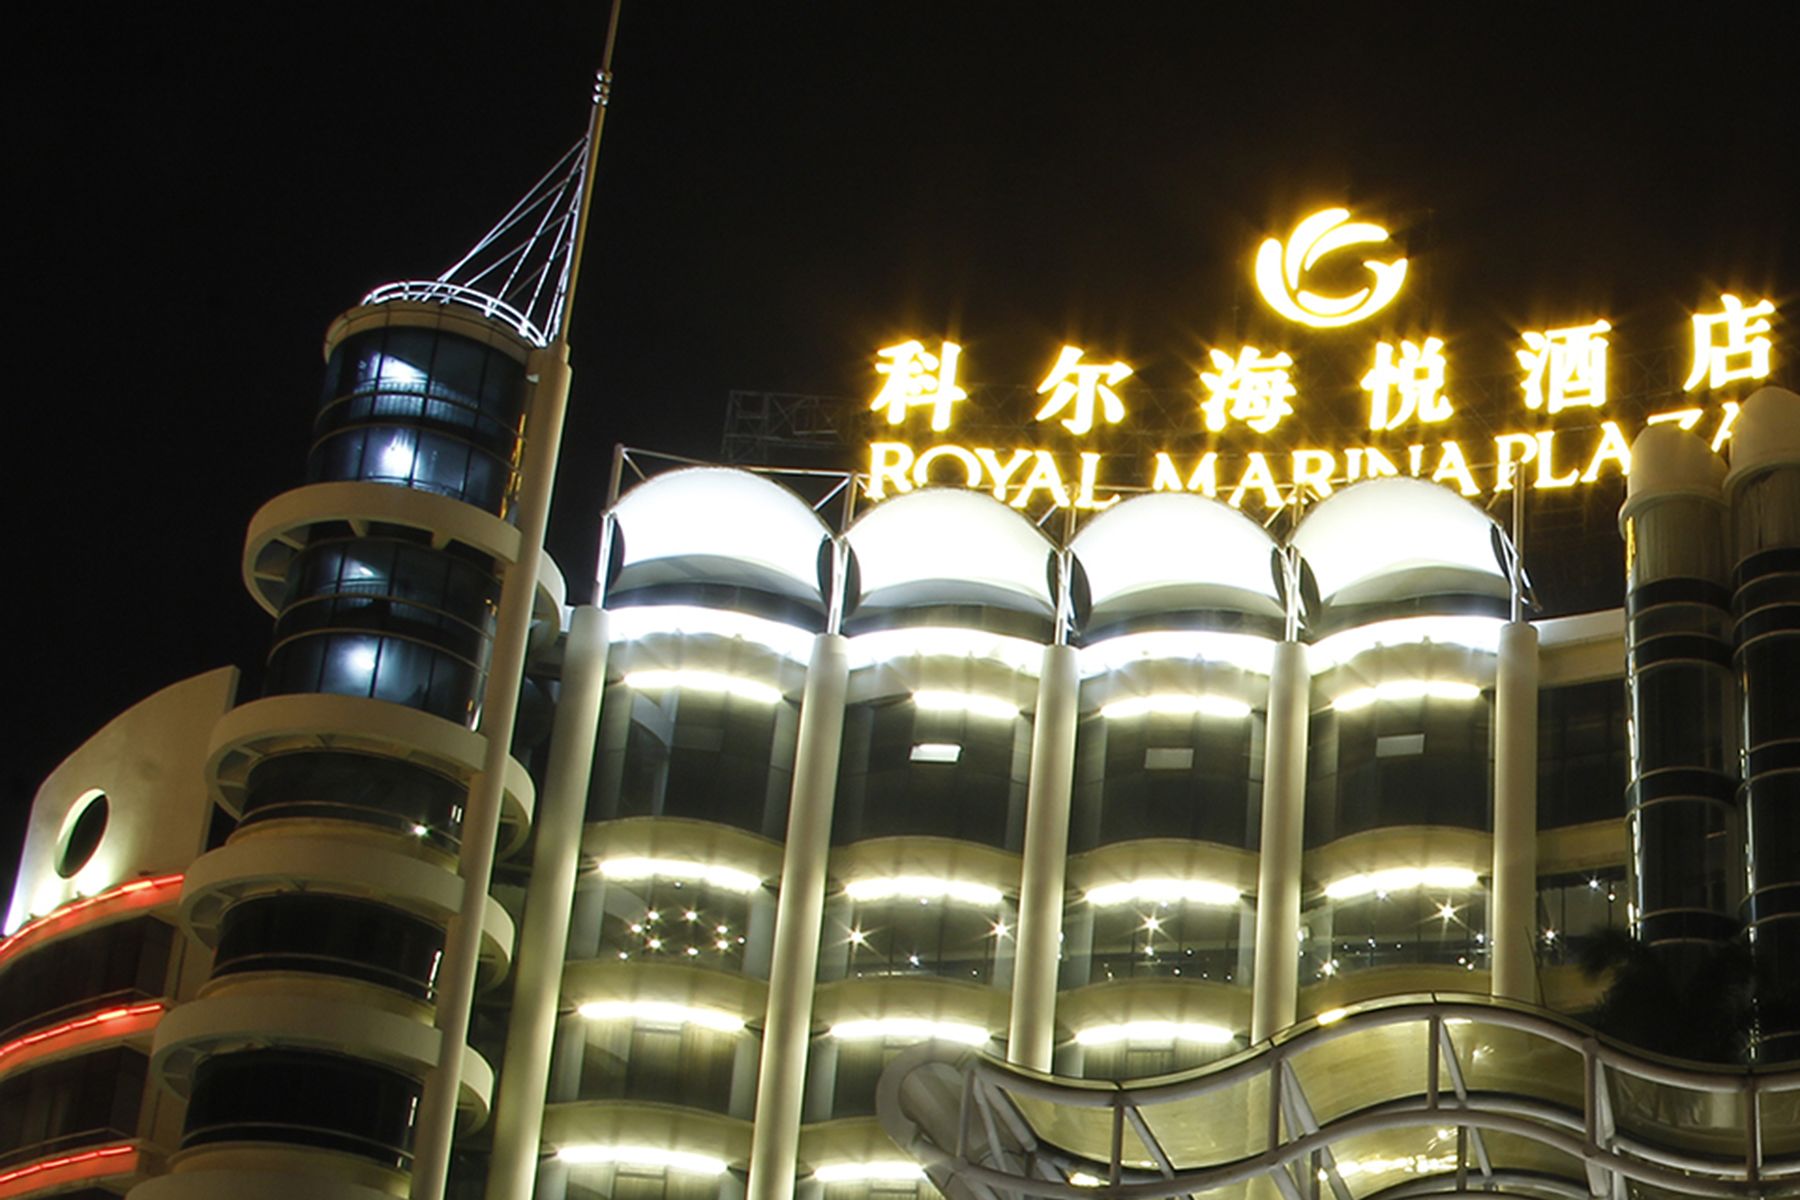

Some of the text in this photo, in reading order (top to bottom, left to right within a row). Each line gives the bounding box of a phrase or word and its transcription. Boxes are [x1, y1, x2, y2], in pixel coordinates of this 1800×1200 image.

[869, 293, 1776, 436] 科尔海悦酒店
[864, 441, 1121, 510] ROYAL
[1493, 401, 1740, 493] PLA
